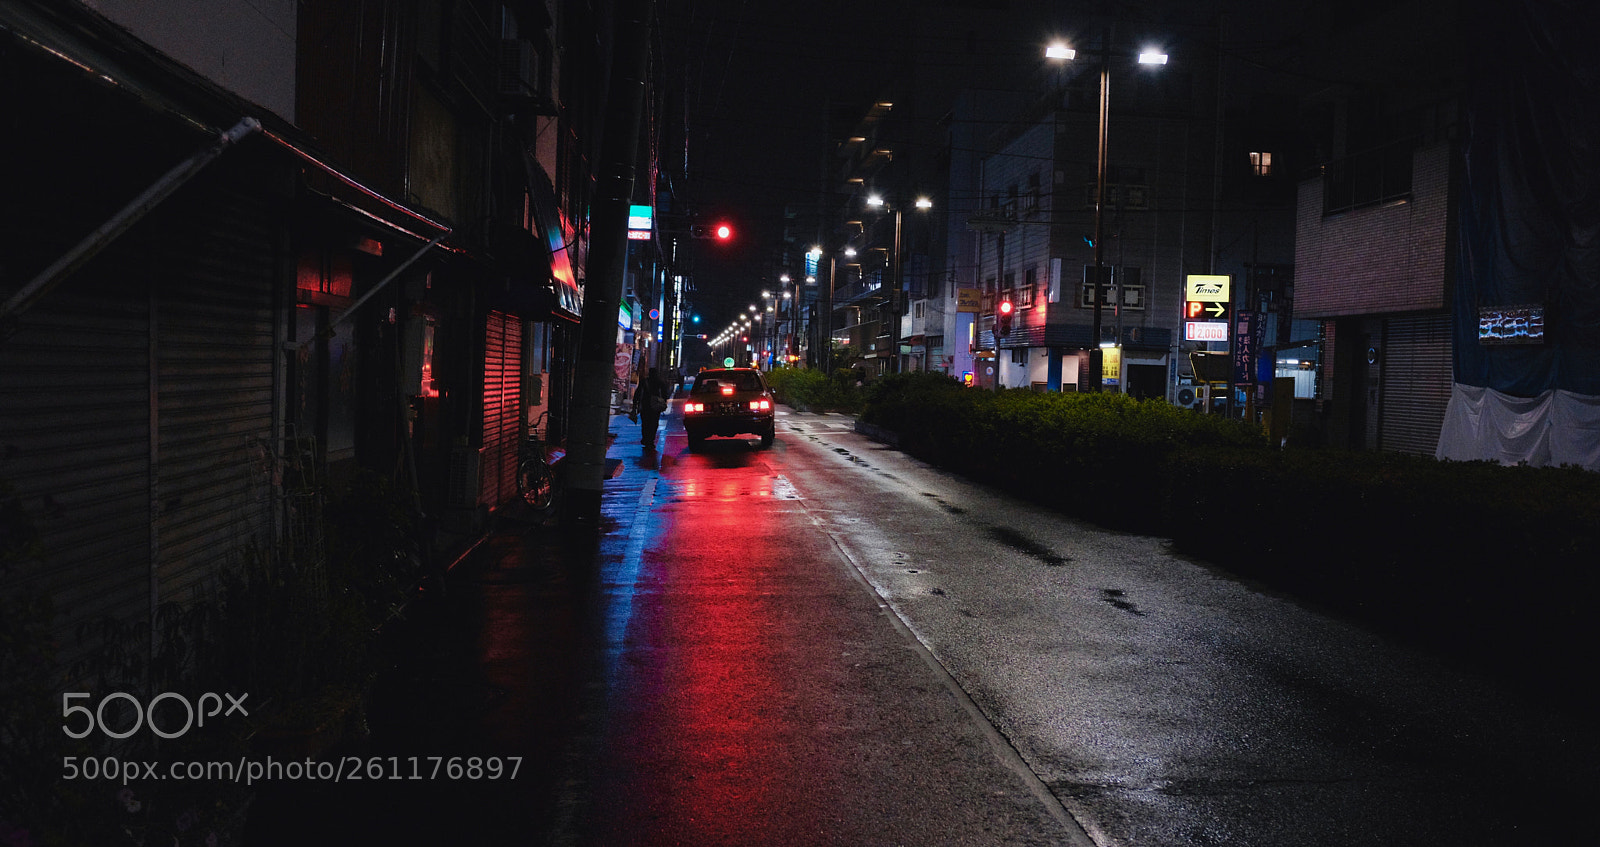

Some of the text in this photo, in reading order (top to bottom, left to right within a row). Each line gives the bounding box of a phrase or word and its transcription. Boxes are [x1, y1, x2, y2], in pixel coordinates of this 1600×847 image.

[1195, 284, 1223, 294] Times
[1190, 302, 1202, 318] P
[1197, 328, 1223, 339] 2,000
